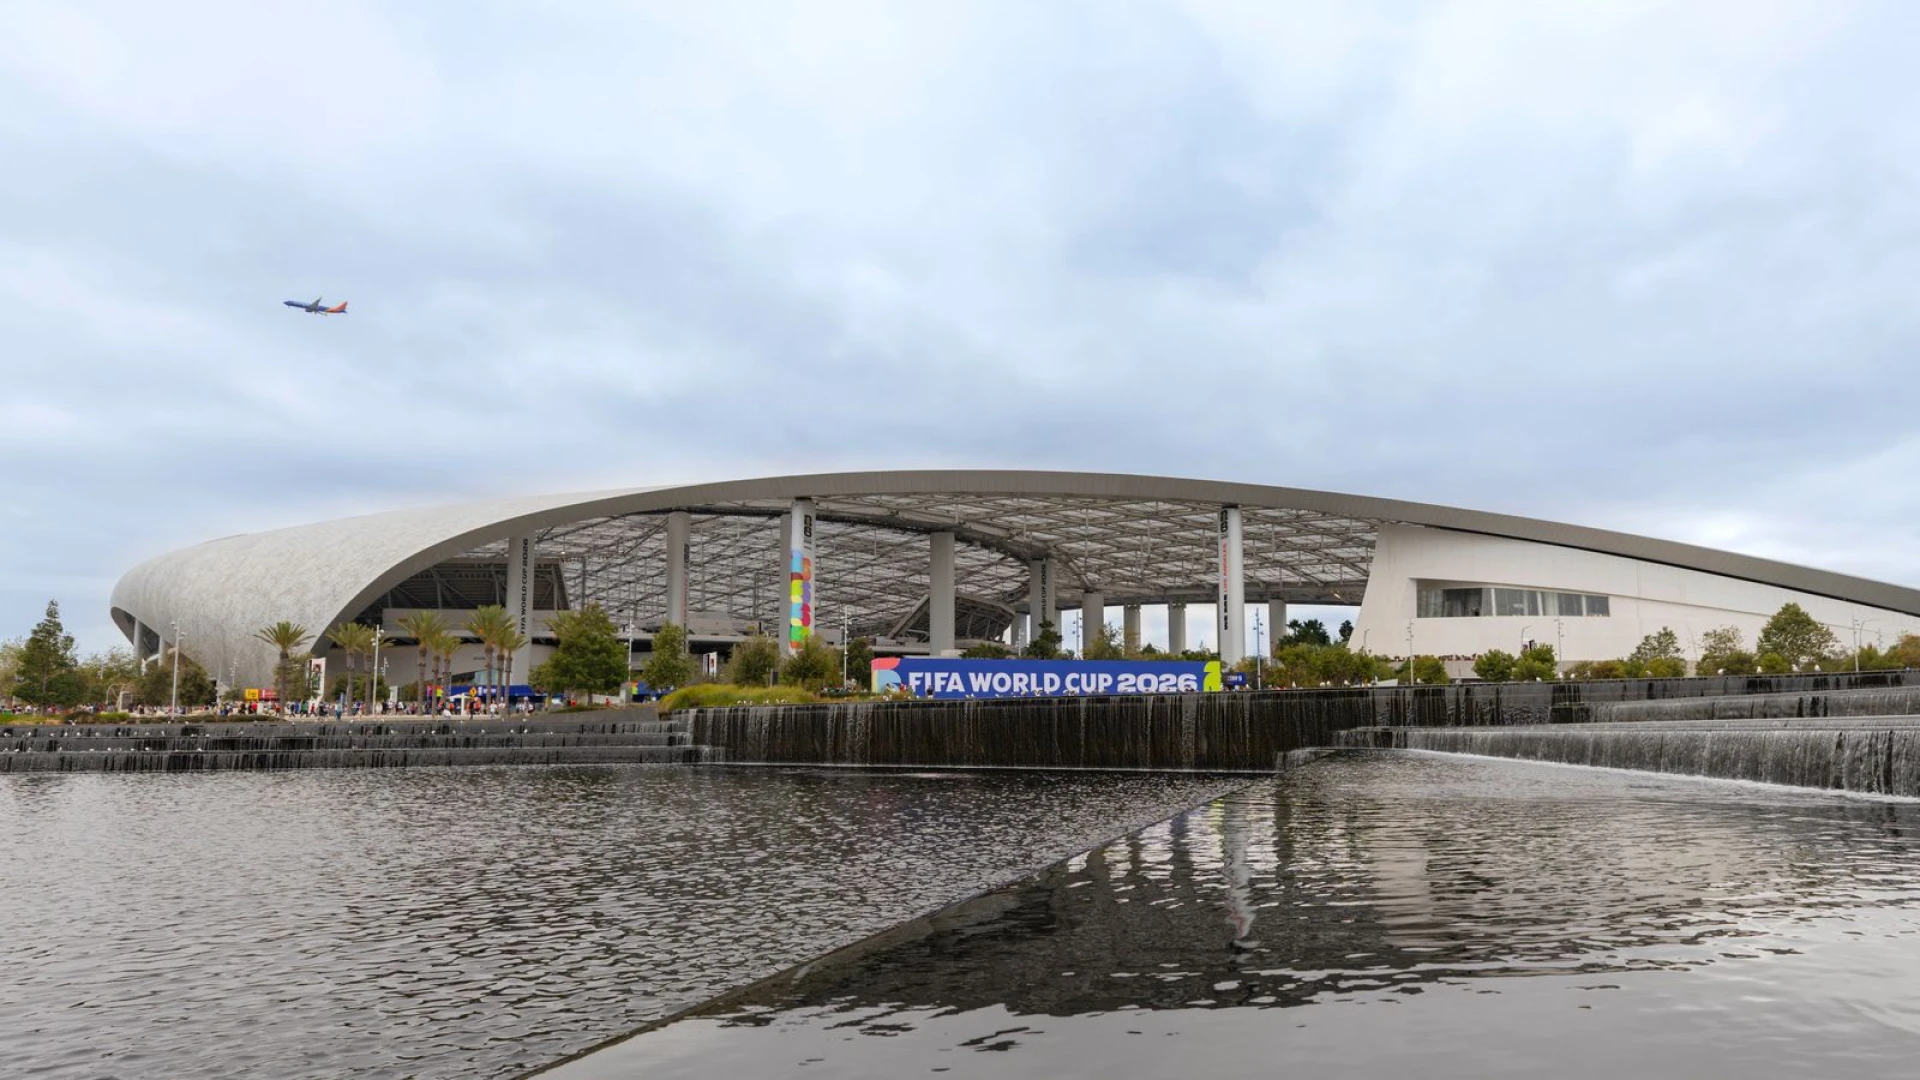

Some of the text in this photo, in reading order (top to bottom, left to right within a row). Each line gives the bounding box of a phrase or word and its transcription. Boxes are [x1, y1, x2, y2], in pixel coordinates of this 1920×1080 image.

[908, 671, 1198, 694] FIFA WORLD CUP 2026
